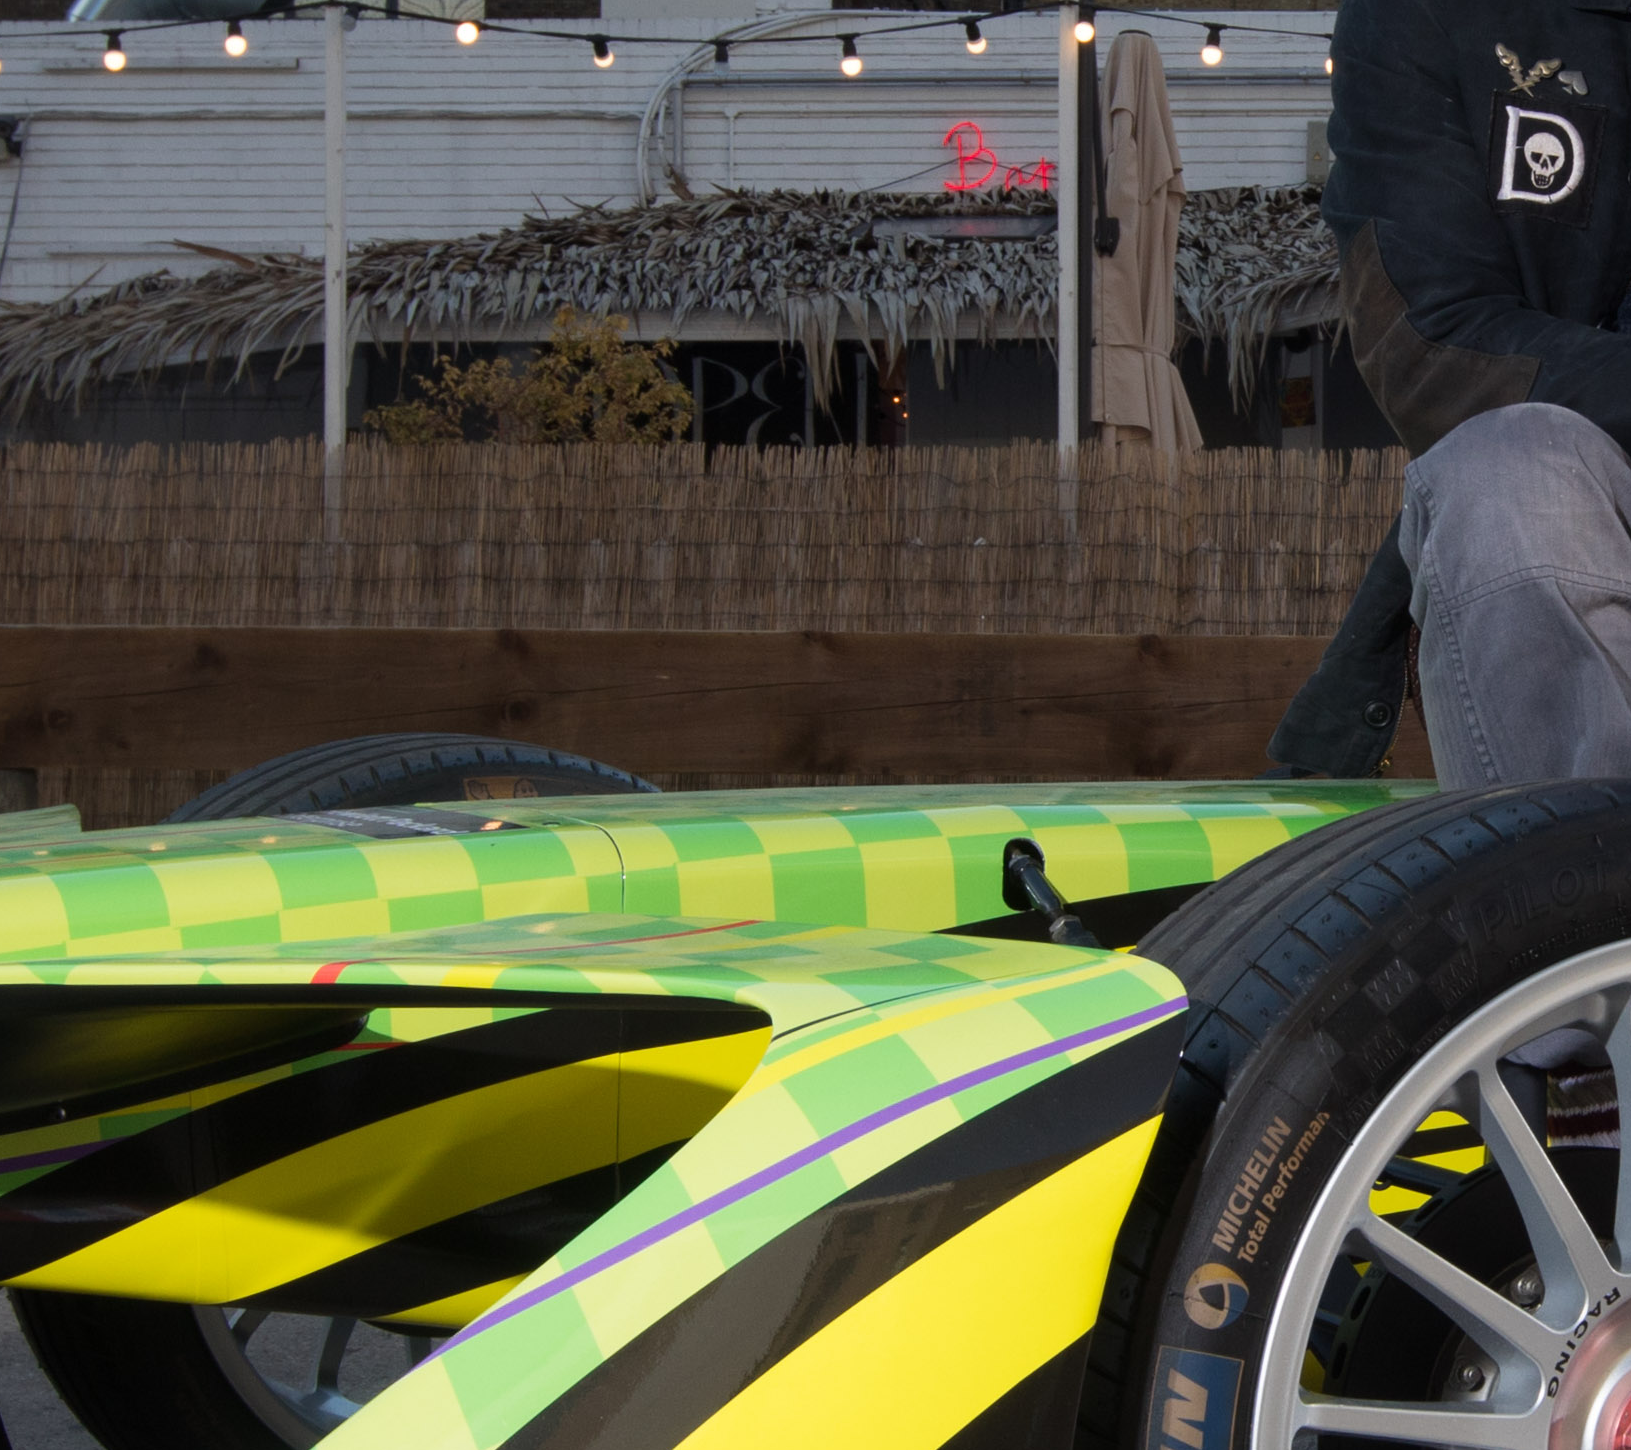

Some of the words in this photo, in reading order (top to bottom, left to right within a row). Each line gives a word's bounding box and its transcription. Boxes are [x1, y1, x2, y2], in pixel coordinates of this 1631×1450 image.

[1468, 851, 1615, 942] PILOT
[1211, 1115, 1293, 1254] MICHELIN
[1236, 1209, 1272, 1263] Total
[1547, 1287, 1621, 1398] RACING
